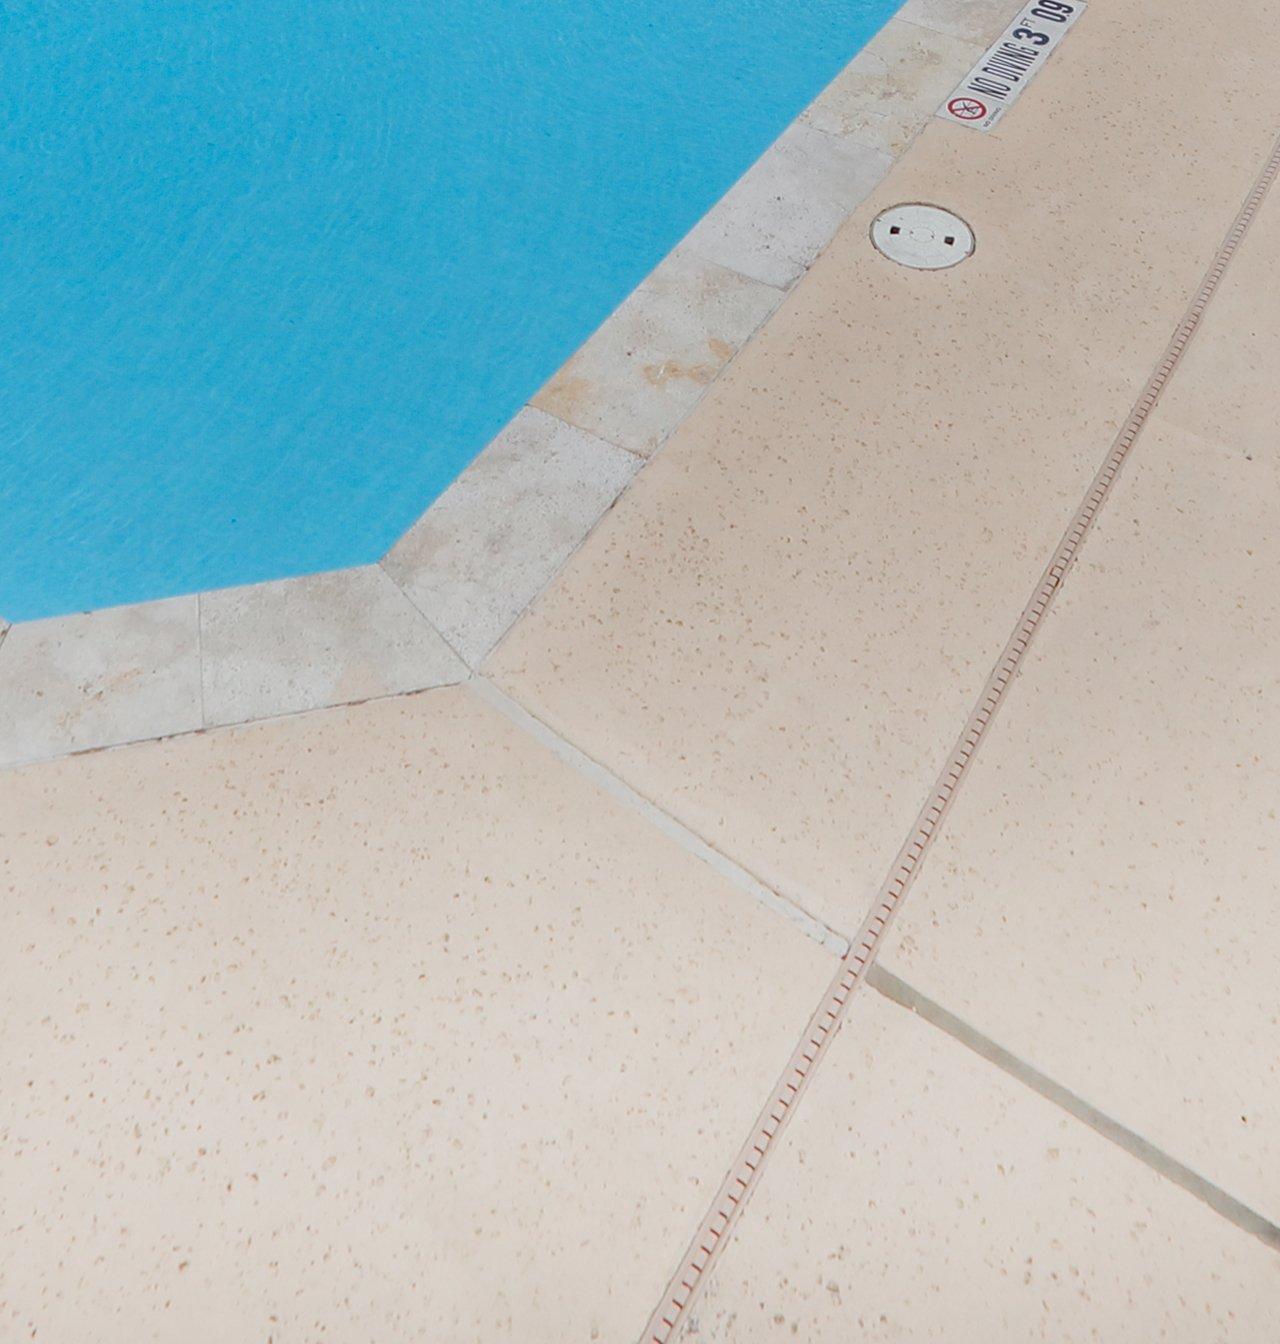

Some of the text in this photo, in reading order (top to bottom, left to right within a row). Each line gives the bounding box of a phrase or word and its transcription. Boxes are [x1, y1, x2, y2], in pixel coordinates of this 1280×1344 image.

[1020, 16, 1036, 29] FT
[1012, 27, 1050, 46] 3
[981, 41, 1040, 82] DIVING
[967, 76, 1011, 101] NO
